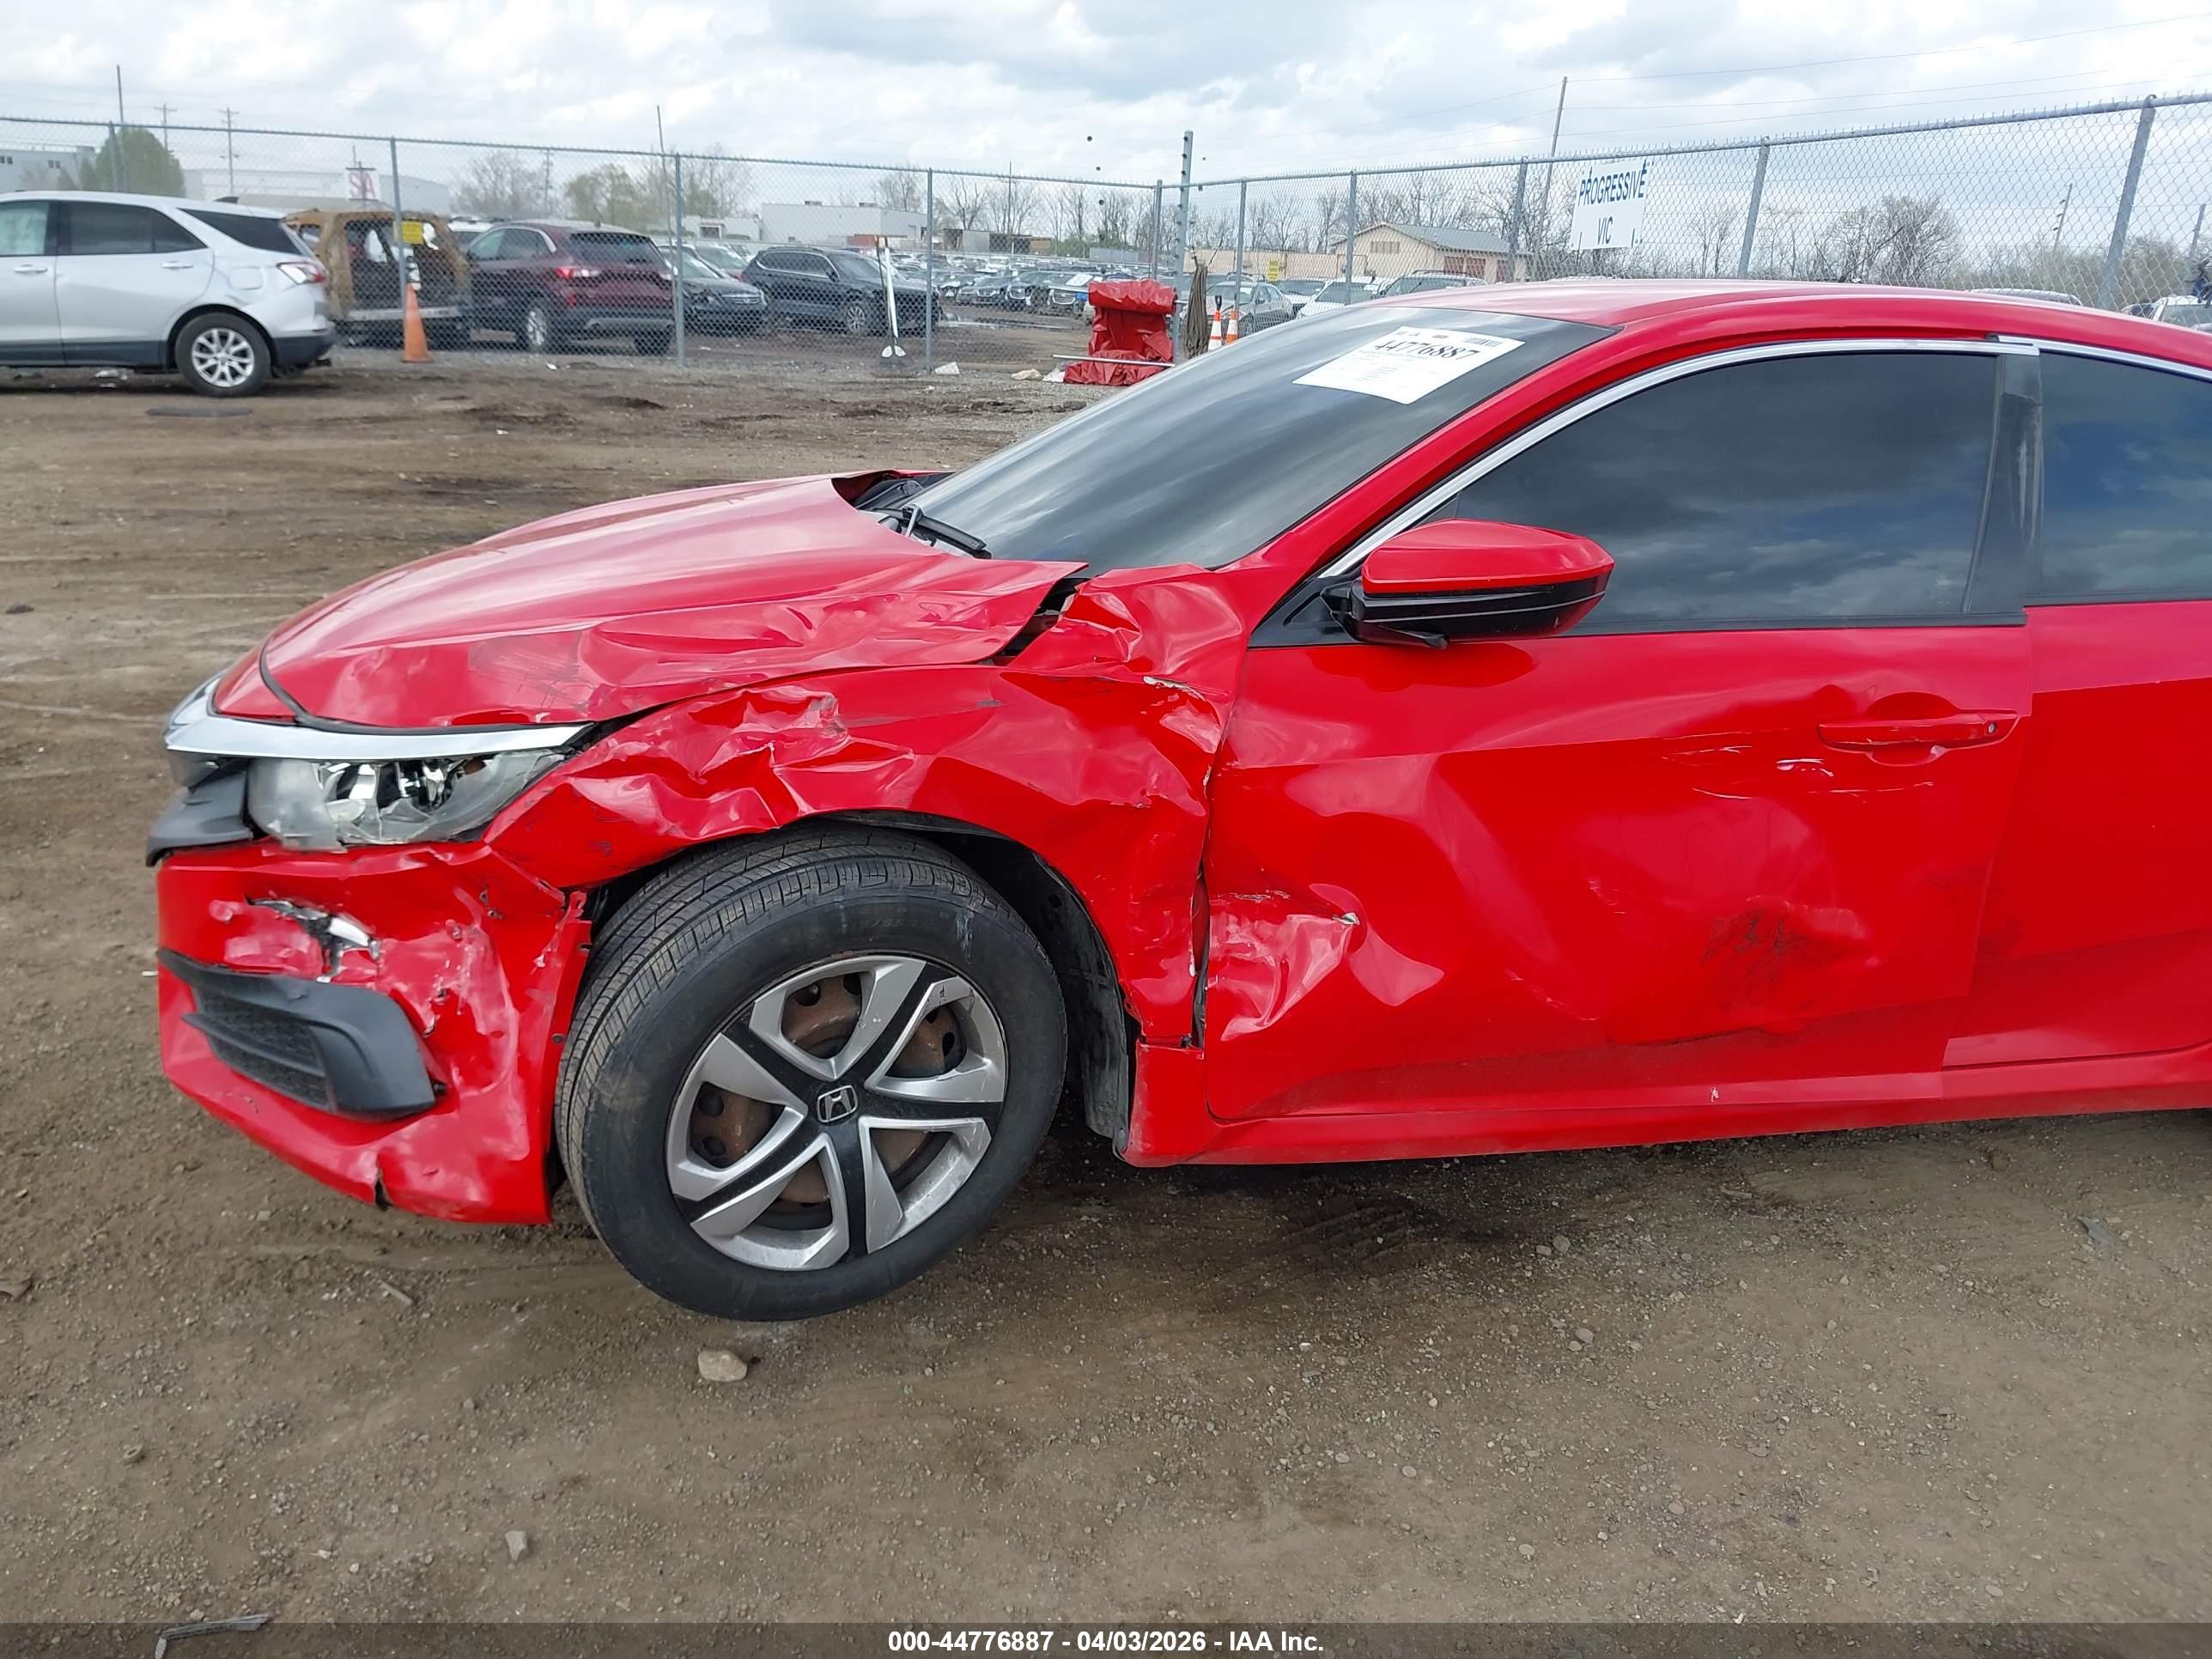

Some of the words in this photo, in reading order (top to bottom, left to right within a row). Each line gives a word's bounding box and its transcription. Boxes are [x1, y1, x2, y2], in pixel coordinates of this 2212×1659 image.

[1577, 170, 1647, 206] PROGRESSIVE
[1597, 216, 1613, 245] VIC
[1375, 340, 1481, 360] 44776887
